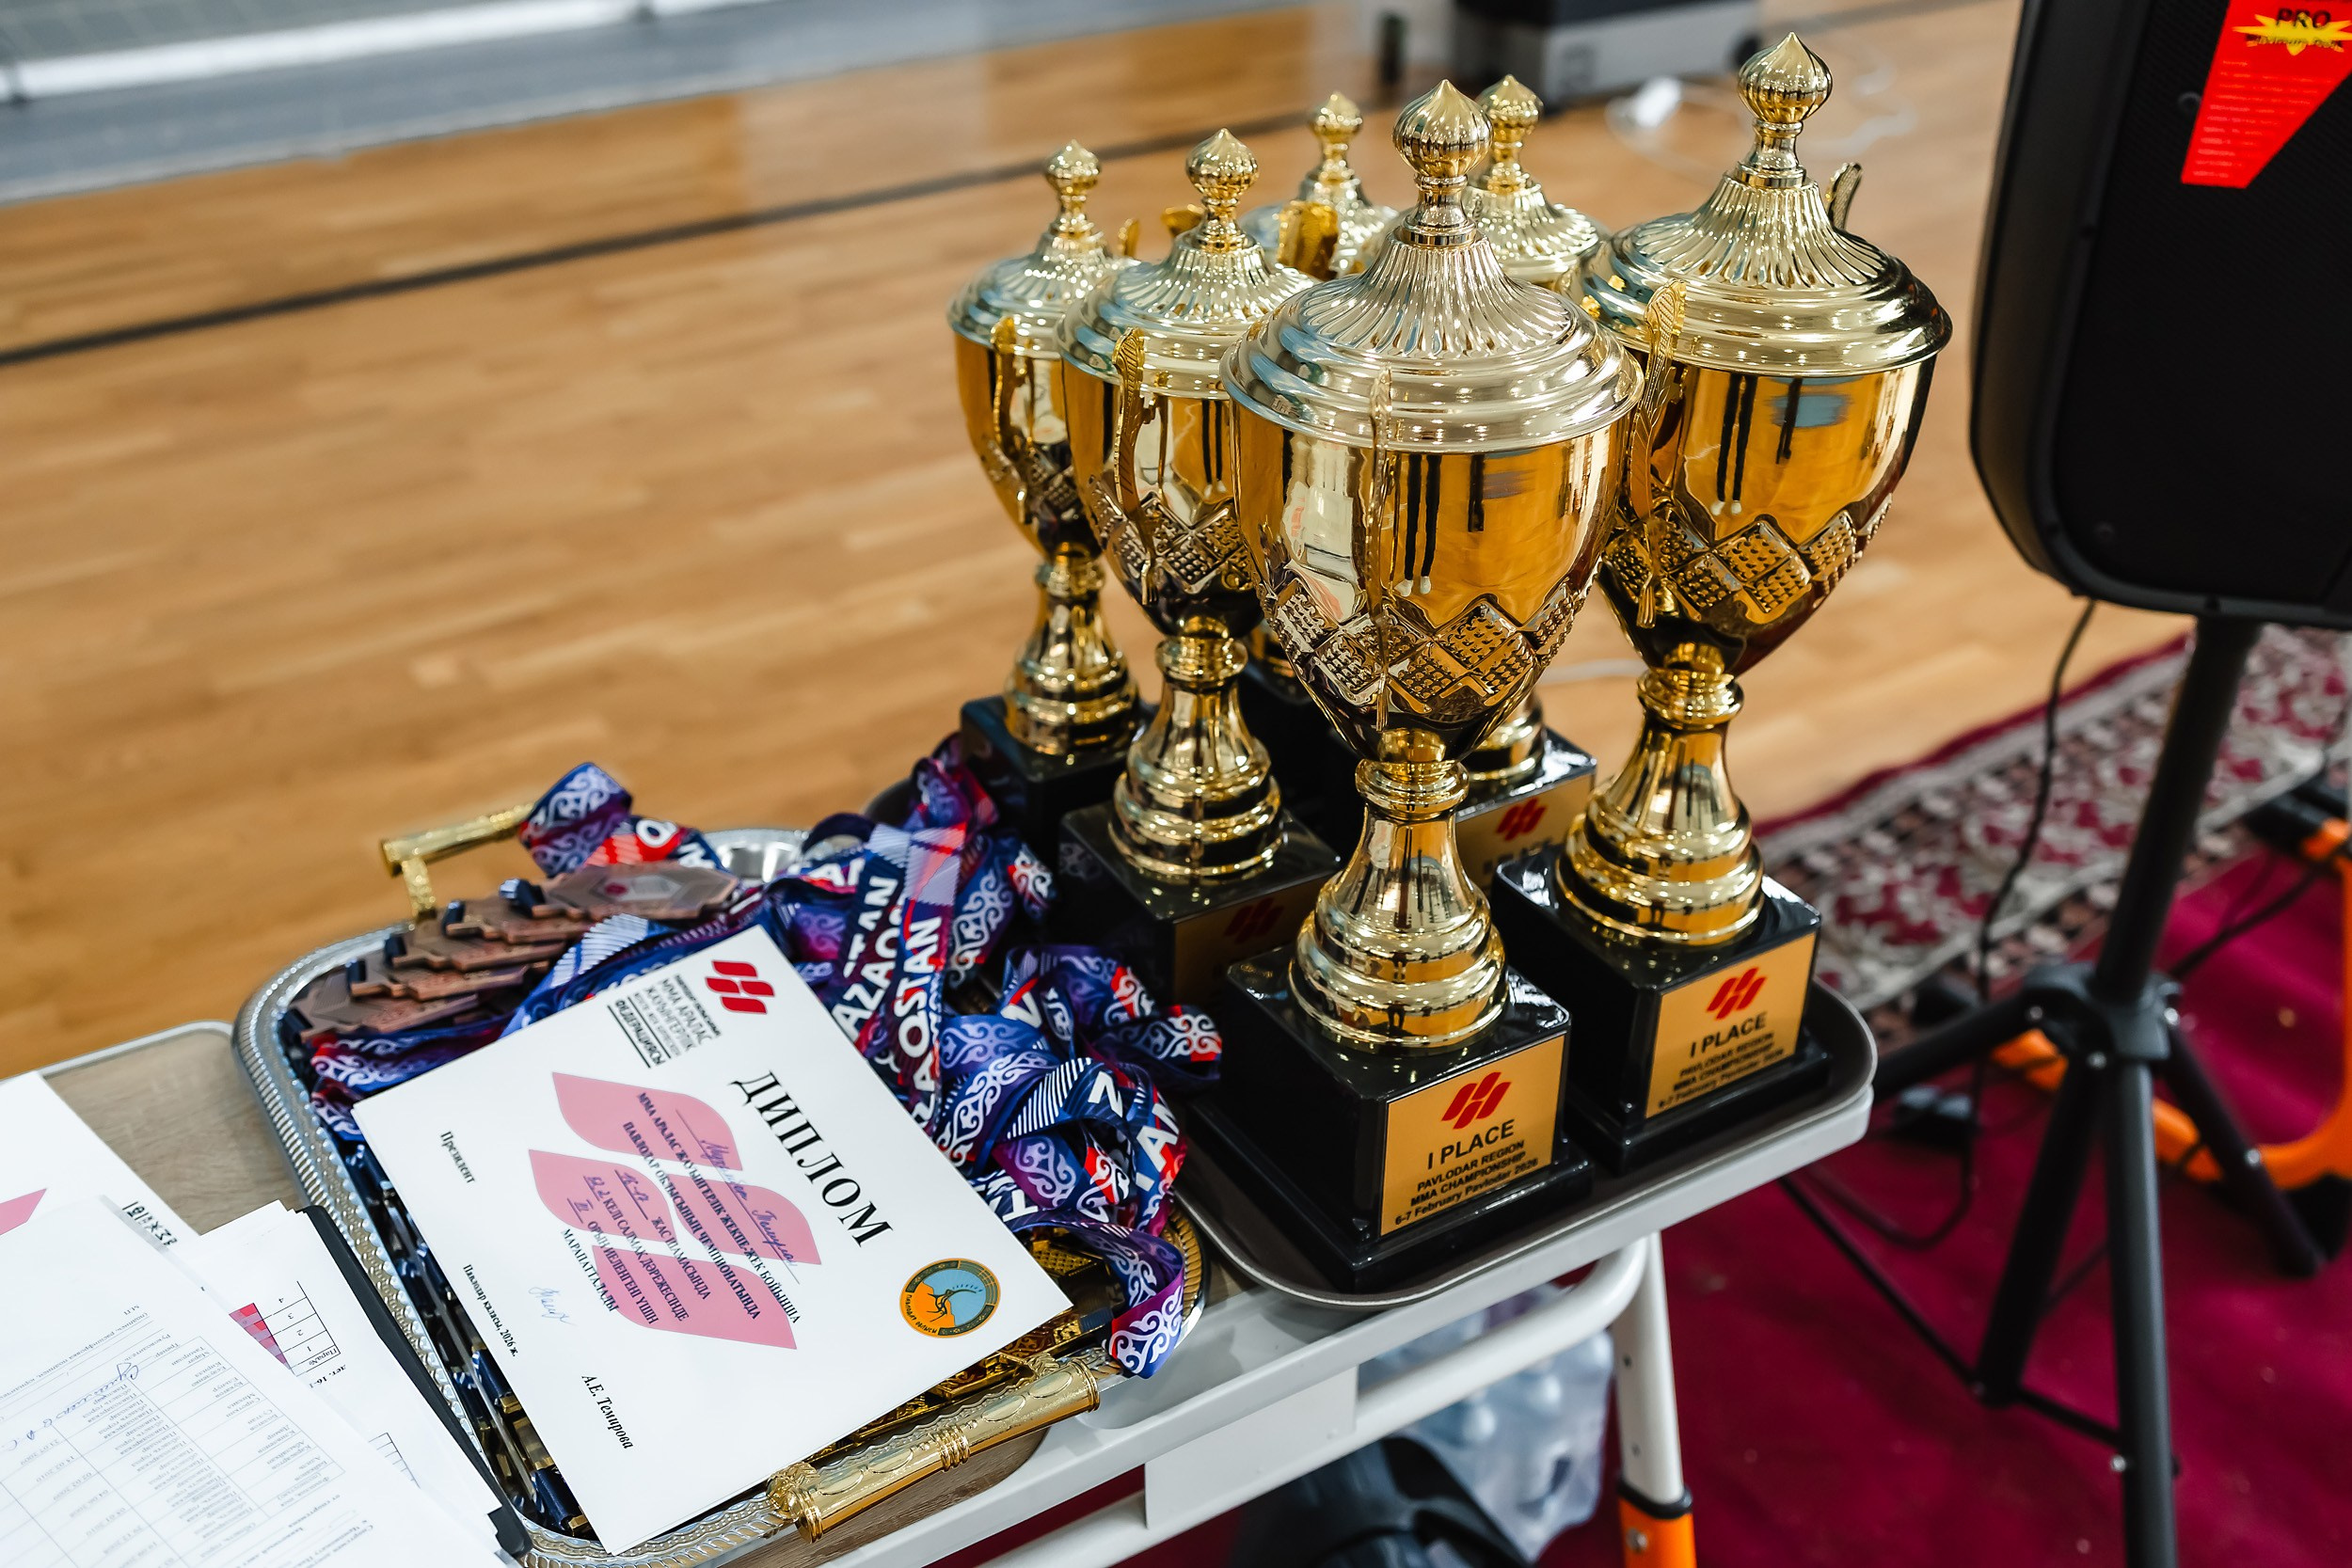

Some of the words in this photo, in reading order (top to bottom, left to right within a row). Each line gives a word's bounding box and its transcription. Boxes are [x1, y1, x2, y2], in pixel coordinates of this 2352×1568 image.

[1690, 1040, 1696, 1058] I
[1701, 1010, 1768, 1053] PLACE
[440, 1131, 474, 1182] Президент
[727, 1070, 893, 1248] ДИПЛОМ
[1417, 1158, 1478, 1192] PAVLODAR
[1481, 1139, 1524, 1164] REGION
[1427, 1151, 1433, 1170] I
[1439, 1117, 1515, 1165] PLACE
[639, 1092, 656, 1117] ММА
[654, 1117, 680, 1148] АРАЛАС
[720, 1213, 763, 1270] ЖЕКПЕ-ЖЕК
[760, 1270, 800, 1323] БОЙЫНША
[1394, 1210, 1411, 1226] 6-7
[1414, 1189, 1462, 1218] February
[1465, 1167, 1511, 1196] Pavlodar
[1410, 1187, 1437, 1207] MMA
[1439, 1149, 1526, 1194] CHAMPIONSHIP
[623, 1121, 659, 1166] ПАВЛОДАР
[657, 1170, 703, 1233] ОБЛЫСЫНЫҢ
[699, 1231, 759, 1318] ЧЕМПИОНАТЫНДА
[564, 1228, 619, 1310] МАРАПАТТАЛАДЫ
[602, 1197, 623, 1220] КЕЛІ
[640, 1258, 689, 1321] ДӘРЕЖЕСІНДЕ
[603, 1247, 642, 1297] ИЕЛЕНГЕНІ
[651, 1216, 672, 1237] ЖАС
[665, 1237, 710, 1299] ШАМАСЫНДА
[463, 1263, 486, 1300] Павлодар
[499, 1328, 515, 1347] 2026
[309, 1347, 337, 1365] Пара№
[581, 1375, 604, 1397] А.Е.
[596, 1397, 632, 1449] Темирова
